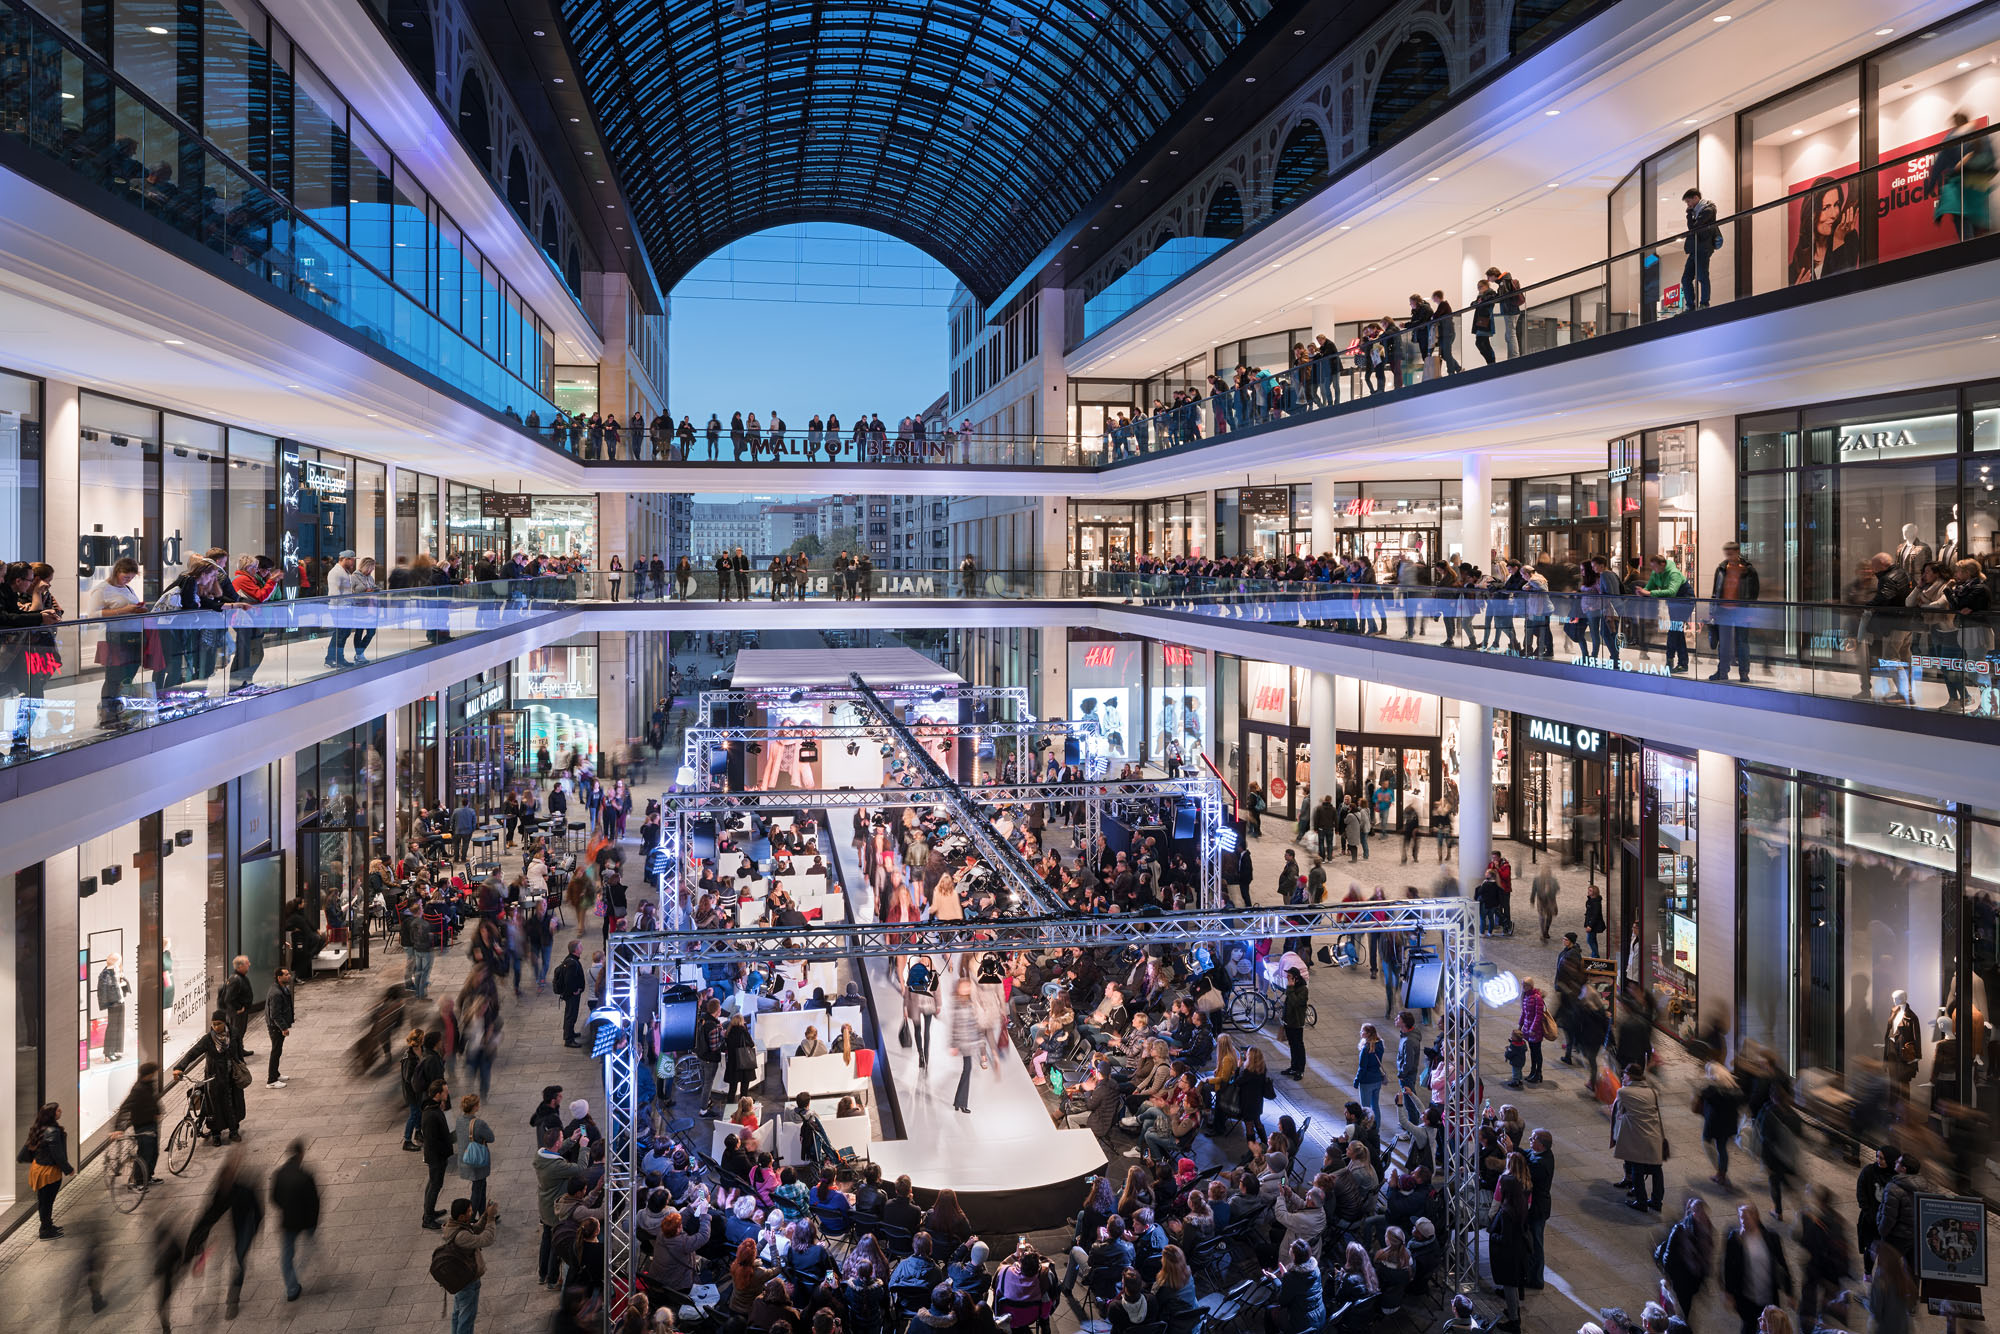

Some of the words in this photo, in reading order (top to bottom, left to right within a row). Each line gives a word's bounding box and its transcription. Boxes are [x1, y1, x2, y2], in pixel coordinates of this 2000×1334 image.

[1891, 177, 1906, 189] die
[1907, 169, 1930, 184] mich
[751, 438, 813, 455] MALL
[824, 439, 855, 456] OF
[867, 439, 946, 457] BERLIN
[1838, 429, 1917, 452] ZARA
[1347, 497, 1376, 517] H&M
[1084, 646, 1115, 668] H&M
[528, 680, 562, 693] KUSMI
[563, 680, 583, 694] TEA
[1256, 685, 1286, 713] H&M
[1379, 695, 1422, 724] H&M
[1530, 719, 1571, 746] MALL
[1576, 729, 1600, 752] OF
[1888, 821, 1955, 850] ZARA
[173, 991, 192, 1015] PARTY
[177, 992, 211, 1025] COLLECTION
